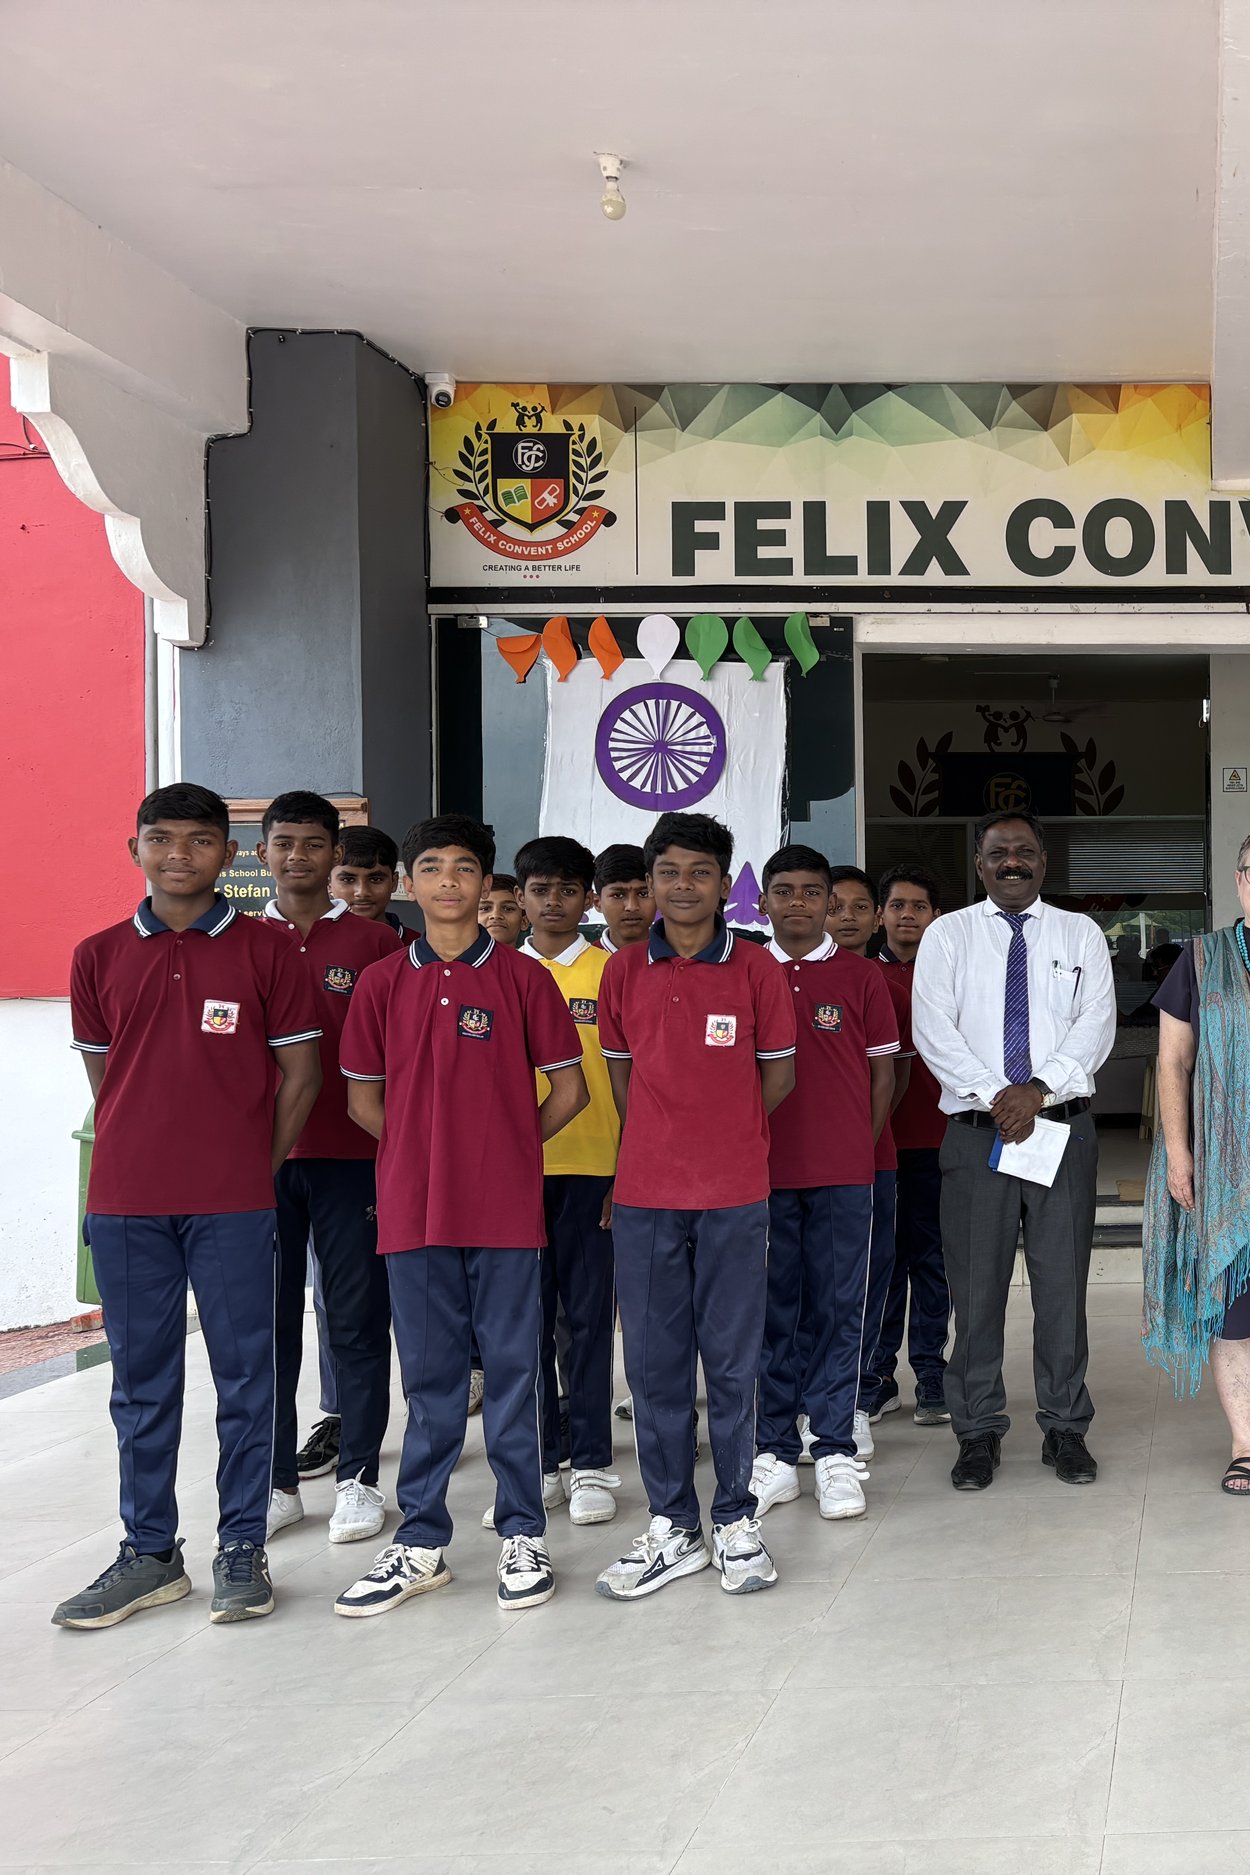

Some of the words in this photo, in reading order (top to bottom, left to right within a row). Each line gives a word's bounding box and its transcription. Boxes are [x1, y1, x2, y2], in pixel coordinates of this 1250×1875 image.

[469, 516, 497, 544] FELIX
[498, 540, 554, 555] CONVENT
[556, 519, 597, 551] SCHOOL
[672, 500, 969, 577] FELIX
[482, 564, 522, 572] CREATING
[523, 564, 530, 572] A
[531, 564, 563, 572] BETTER
[564, 564, 581, 572] LIFE
[228, 869, 258, 878] School
[223, 883, 271, 898] Stefan
[243, 909, 266, 917] servi
